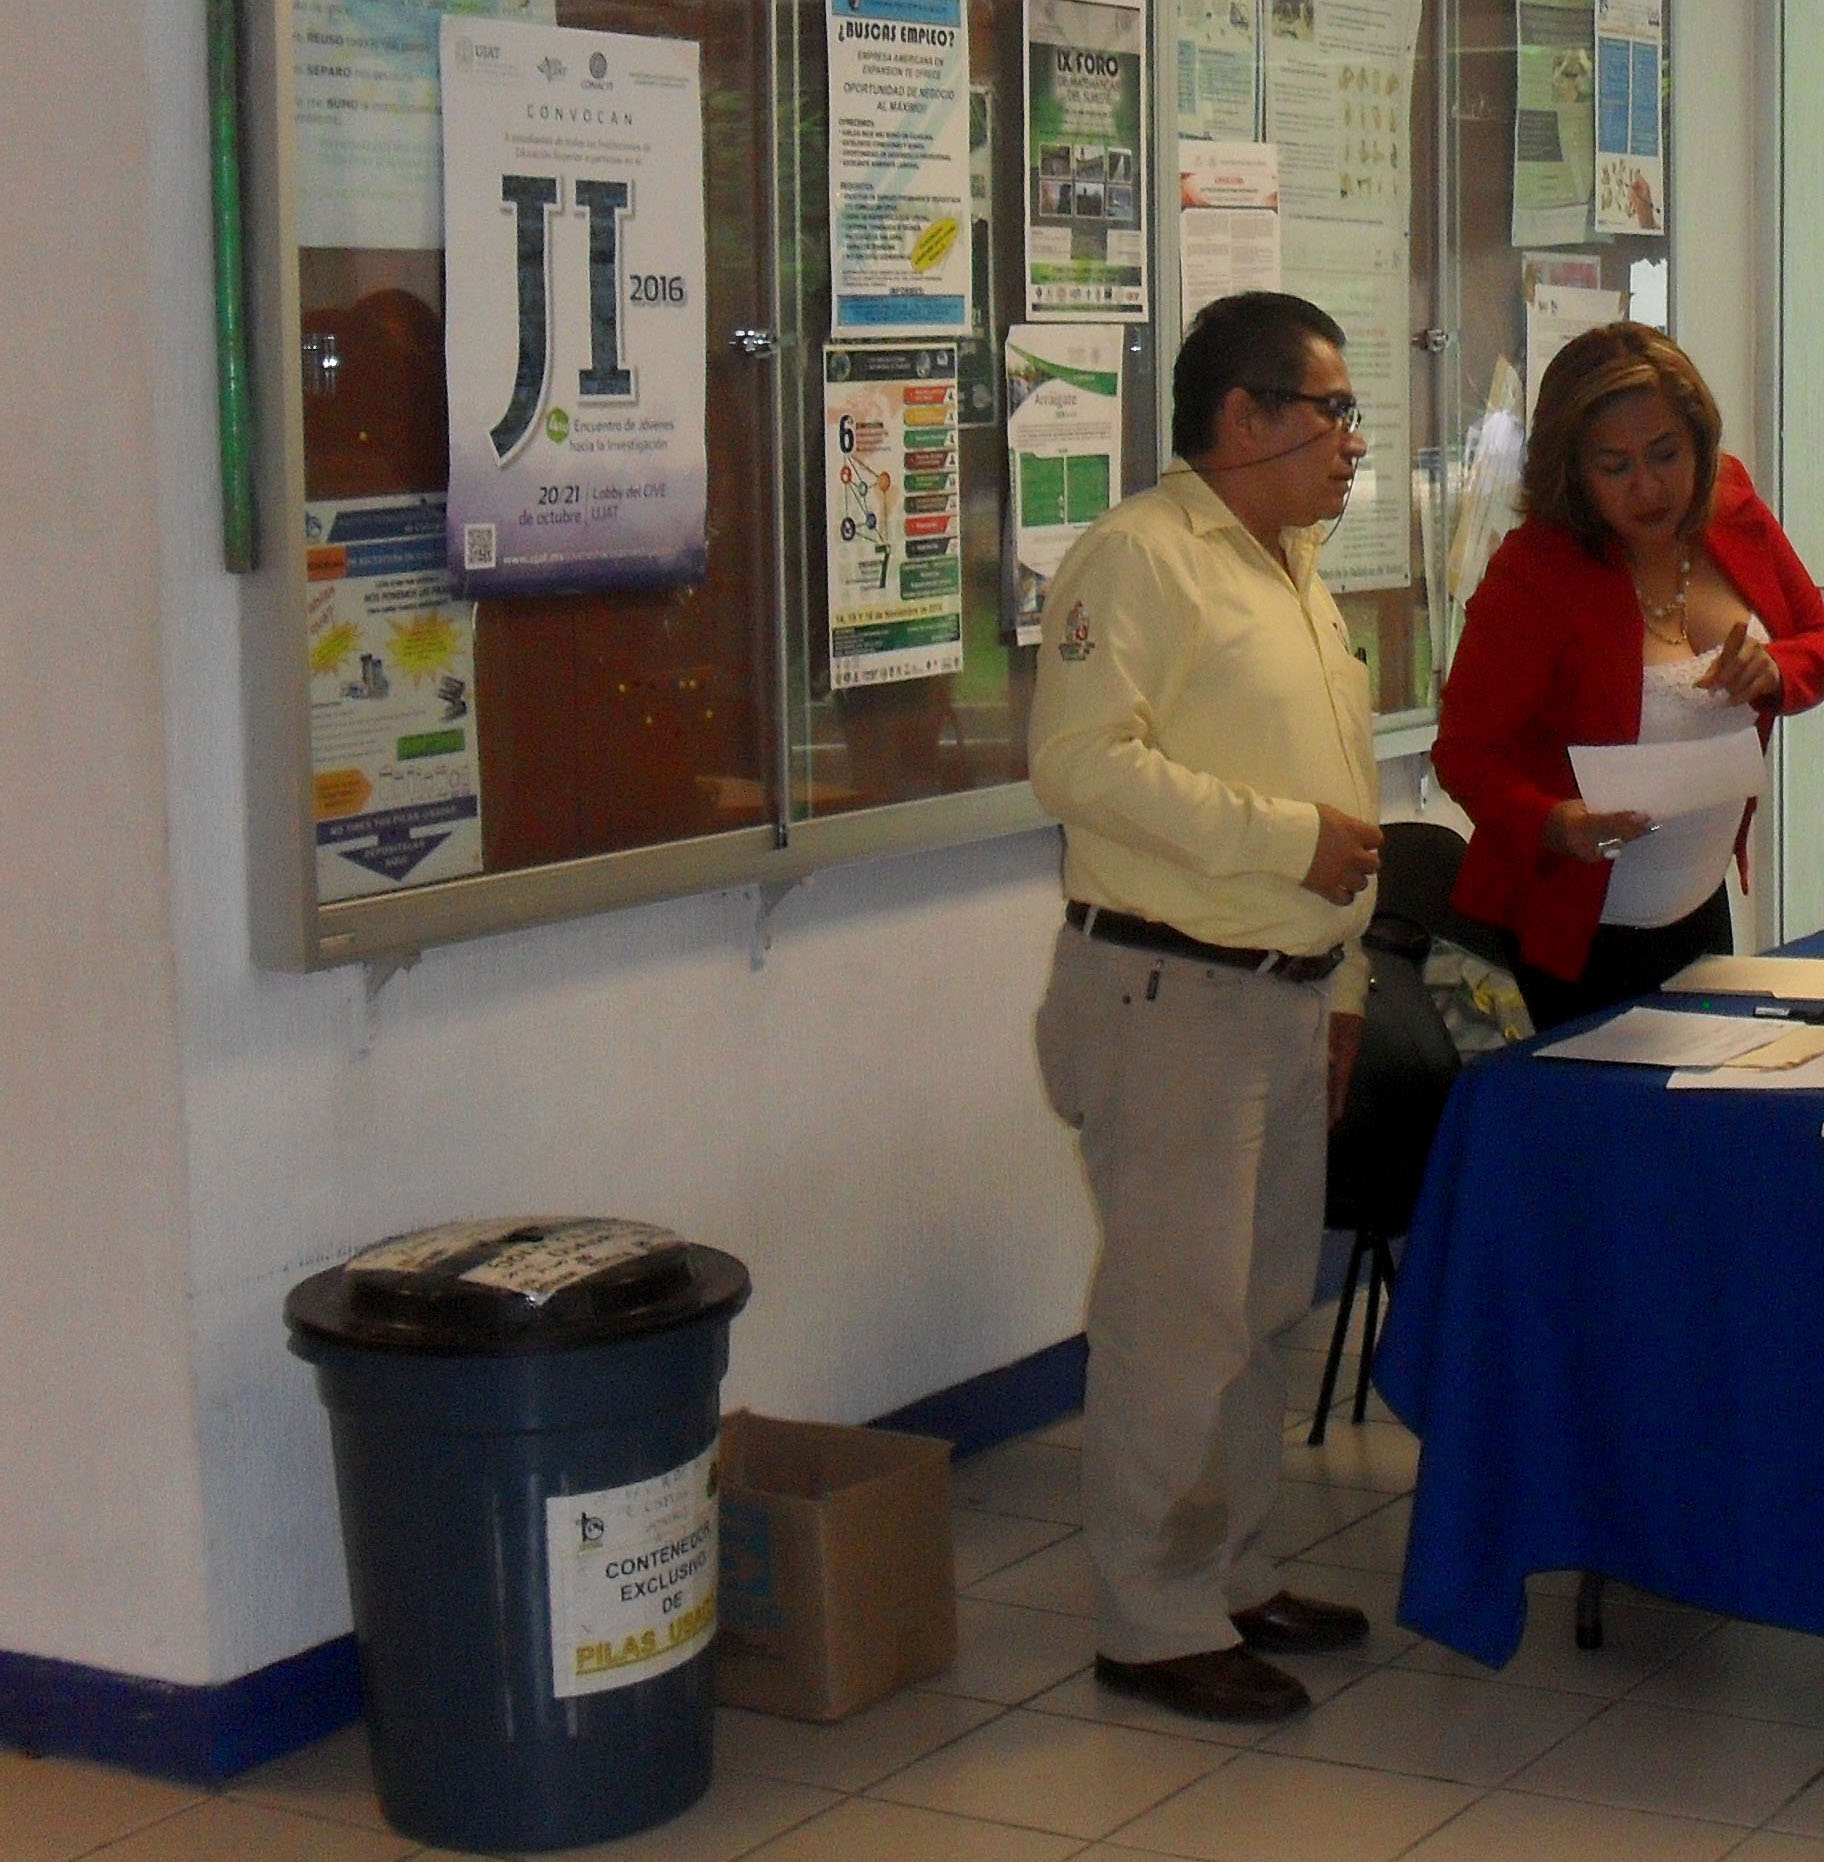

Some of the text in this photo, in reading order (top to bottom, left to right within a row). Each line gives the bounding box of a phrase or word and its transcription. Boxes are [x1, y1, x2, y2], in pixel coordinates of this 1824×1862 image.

[838, 21, 955, 48] ¿BUSCAS EMPLEO?
[1057, 50, 1119, 77] IX FORO
[843, 82, 955, 100] OPORTUNIDAD DE NEGOCIO
[526, 103, 633, 126] CONVOCAN
[629, 275, 684, 302] 2016
[488, 174, 631, 460] JI
[574, 419, 620, 433] Encuentro
[839, 414, 855, 455] 6
[537, 485, 581, 505] 20 21
[592, 484, 624, 502] Lobby
[625, 484, 642, 498] del
[519, 509, 581, 526] de octubre
[605, 1520, 711, 1580] CONTENEDOR
[619, 1554, 708, 1603] EXCLUSIVO
[662, 1590, 684, 1615] DE
[575, 1631, 657, 1670] PILAS
